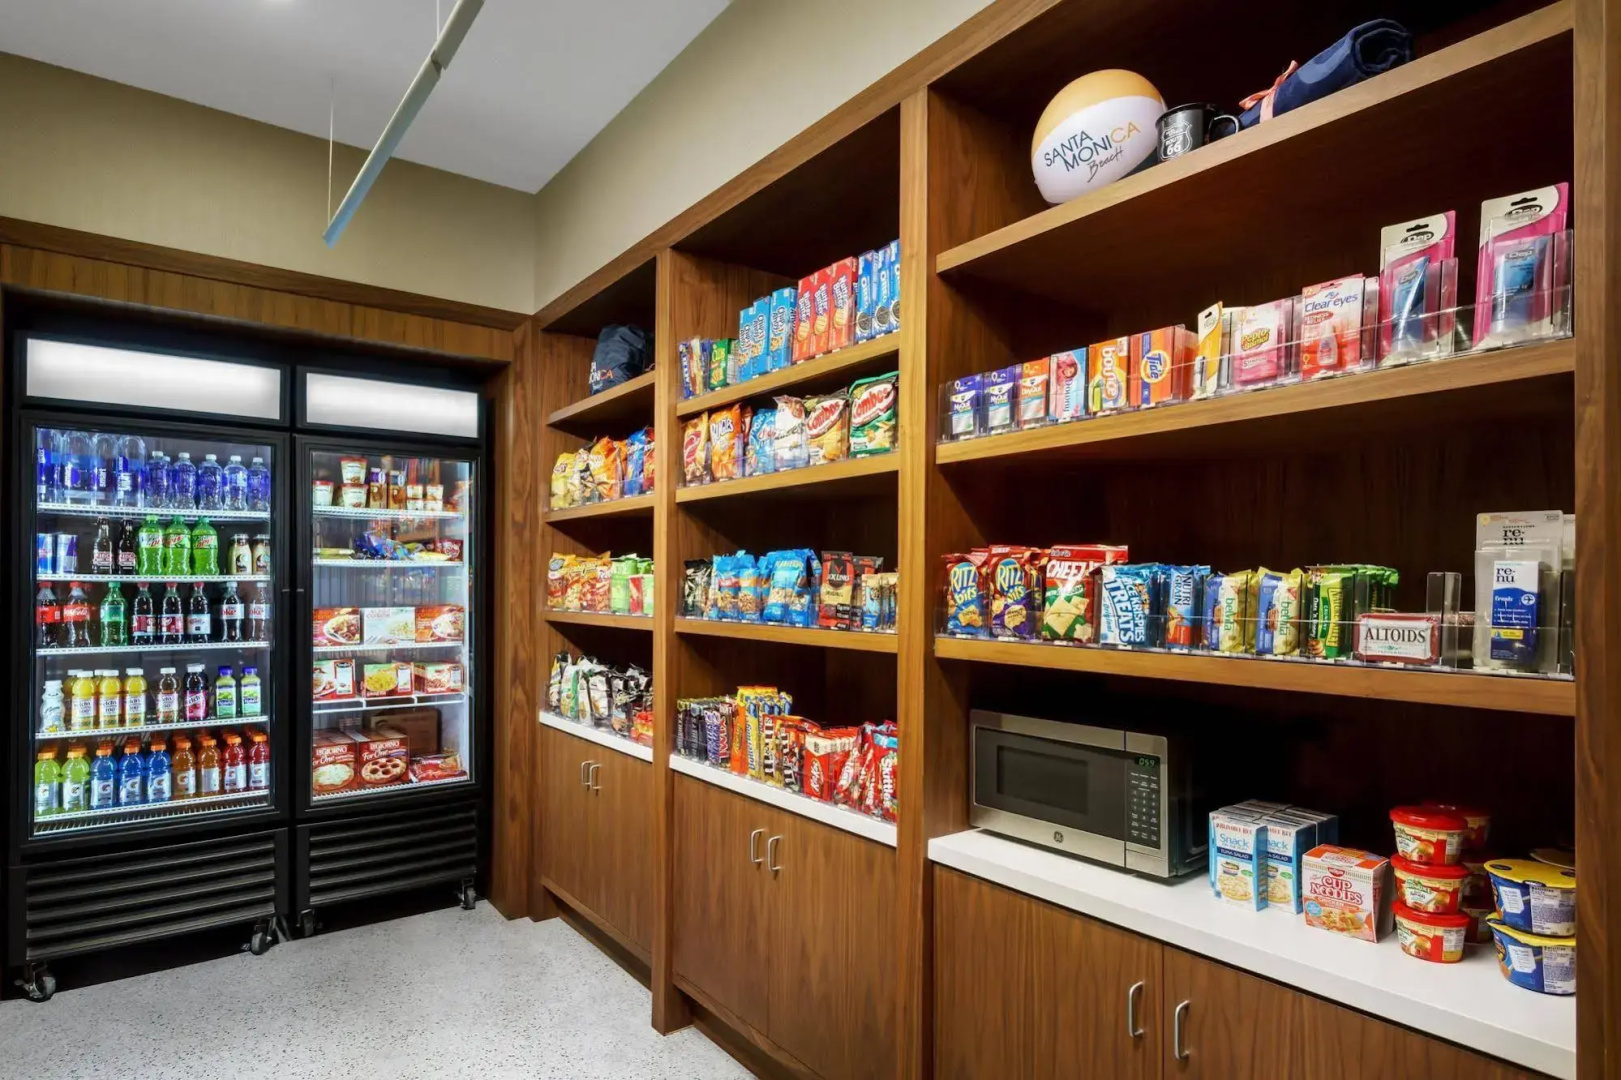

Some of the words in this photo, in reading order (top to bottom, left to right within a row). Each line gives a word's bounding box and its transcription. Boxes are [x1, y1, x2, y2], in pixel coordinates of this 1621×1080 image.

[1044, 130, 1093, 167] SANTA
[1059, 121, 1141, 172] MONICA
[1167, 141, 1181, 155] 66
[1305, 299, 1331, 313] Clear
[1333, 291, 1358, 308] eyes
[1102, 345, 1118, 400] bounce
[1146, 352, 1163, 380] Tide
[1063, 376, 1073, 412] Downy
[951, 566, 977, 593] RITZ
[998, 564, 1022, 591] RITZ
[1174, 574, 1183, 606] GRAIN
[1182, 574, 1192, 606] NUTRI
[1104, 577, 1135, 643] TREATS
[1130, 598, 1145, 642] KRISPIES
[1365, 628, 1427, 643] ALTOIDS
[881, 757, 894, 808] Skittles
[1220, 833, 1249, 849] Snack
[1267, 839, 1289, 850] nack
[1233, 851, 1249, 859] SALAD
[1272, 853, 1289, 861] SALAD
[1310, 882, 1363, 905] NOODLES
[1322, 876, 1352, 891] CUP
